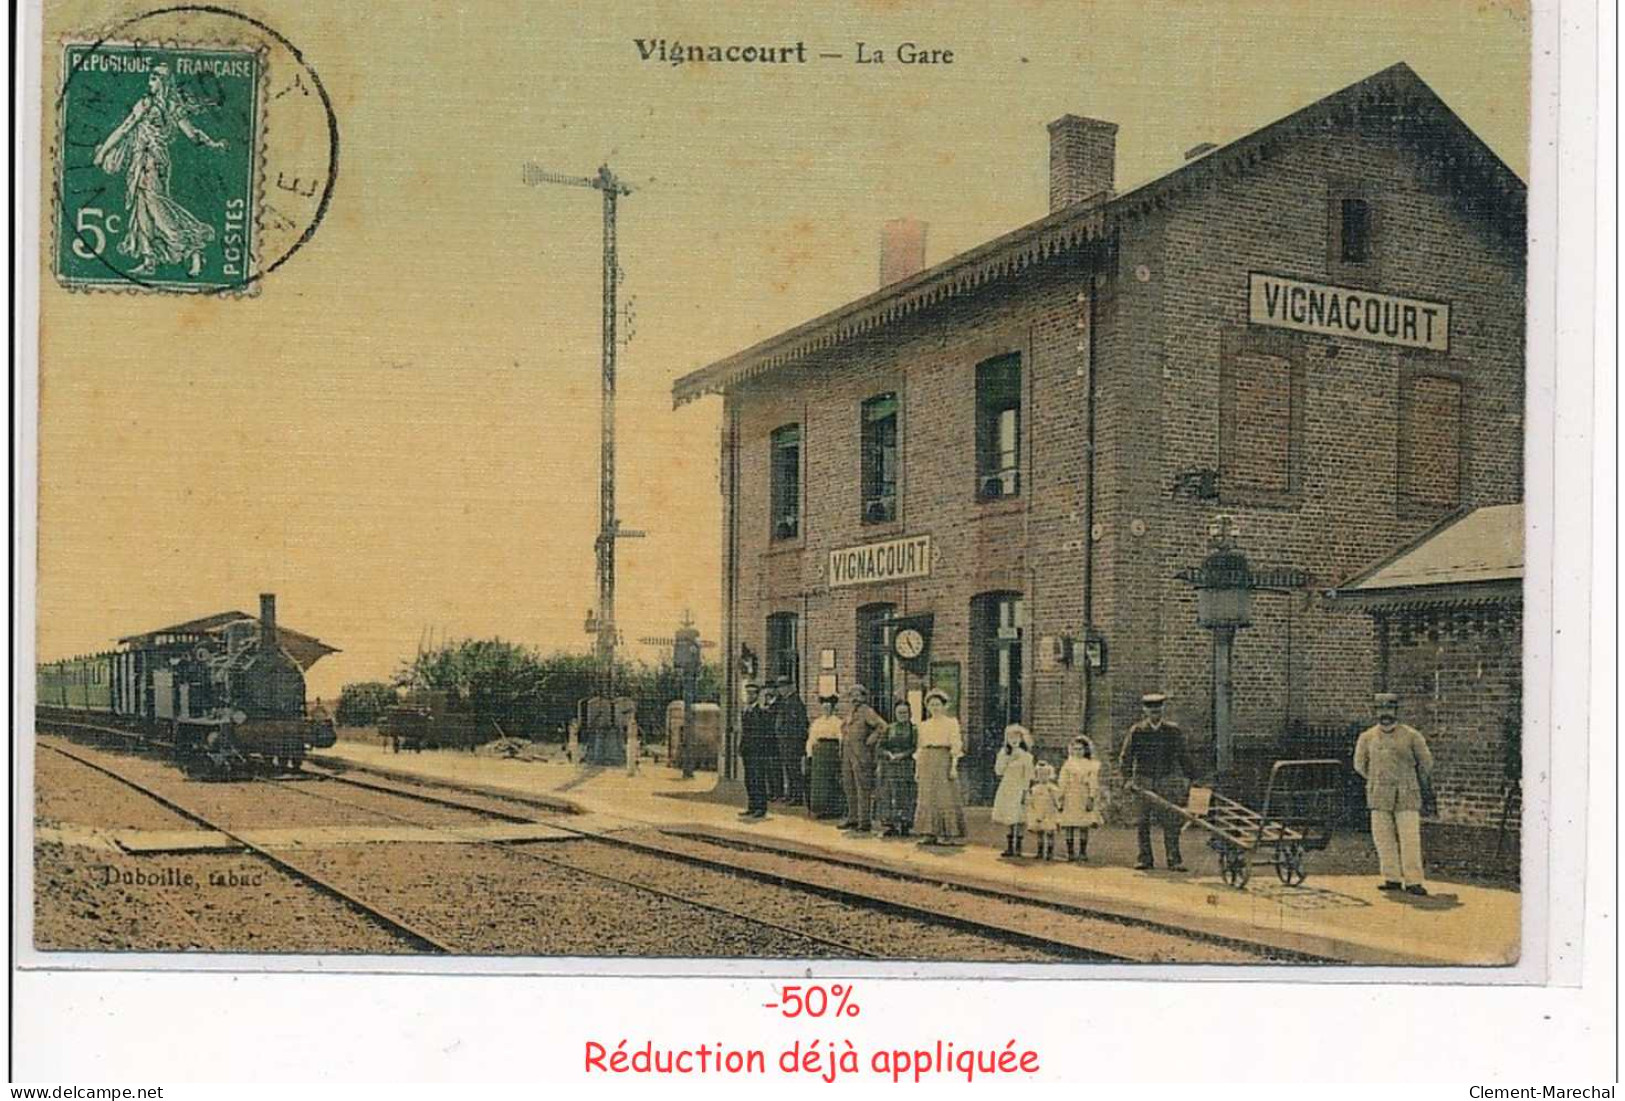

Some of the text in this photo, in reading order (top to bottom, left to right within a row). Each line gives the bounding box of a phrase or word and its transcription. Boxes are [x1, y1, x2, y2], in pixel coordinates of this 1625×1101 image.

[176, 57, 251, 78] FRANÇAISE
[634, 39, 806, 66] Vignacourt
[856, 43, 884, 63] La
[897, 43, 953, 63] Gare
[223, 198, 244, 276] POSTES
[1264, 281, 1438, 343] VIGNACOURT
[832, 540, 928, 582] VIGNACOURT
